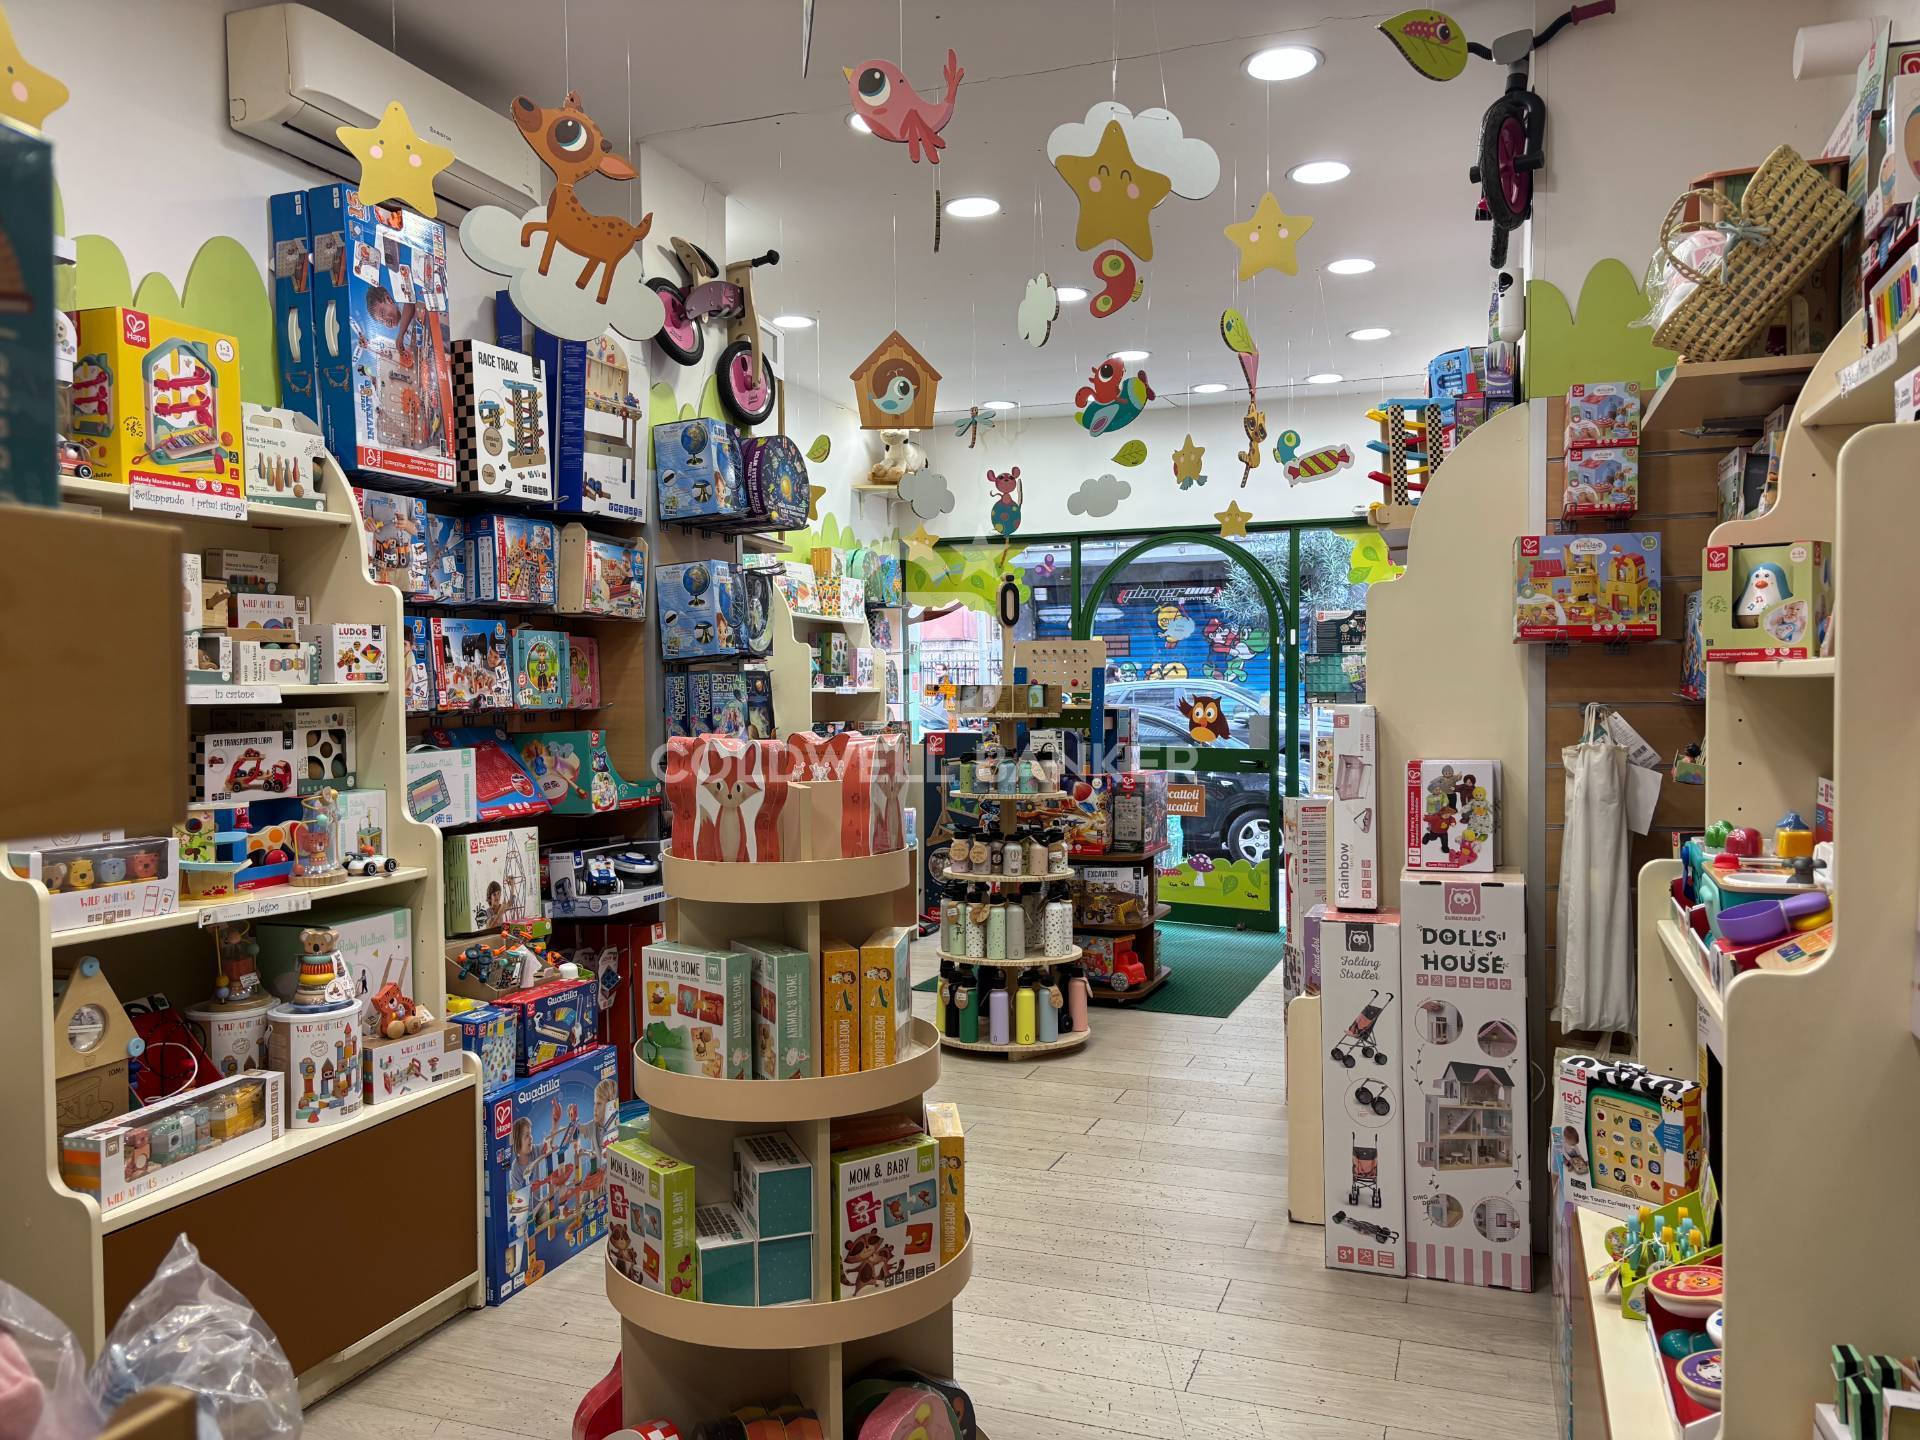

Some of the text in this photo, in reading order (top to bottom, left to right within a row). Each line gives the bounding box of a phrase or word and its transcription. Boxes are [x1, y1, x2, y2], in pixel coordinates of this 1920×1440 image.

[126, 331, 147, 343] Hape
[478, 351, 518, 375] RACE TRACK
[242, 599, 258, 608] WILD
[339, 627, 368, 636] LUDOS
[711, 673, 745, 683] CRYSTAL
[224, 737, 257, 747] TRANSPORTER
[258, 736, 273, 745] LORRY
[1167, 789, 1200, 800] cattoli
[1167, 802, 1199, 813] ucativi
[479, 834, 509, 846] FLEXISTIX
[1087, 870, 1118, 878] EXCAVATOR
[1338, 842, 1350, 899] Rainbow
[648, 956, 679, 973] ANIMAL'S
[681, 960, 700, 977] HOME
[1339, 955, 1381, 971] Folding
[1422, 953, 1505, 974] HOUSE
[1339, 969, 1380, 981] Stroller
[733, 972, 742, 998] HOME
[547, 990, 578, 1006] Quadrilla
[786, 973, 798, 1039] ANIMAL'S HOME
[217, 1023, 235, 1033] WILD
[296, 1023, 314, 1033] WILD
[839, 1019, 850, 1073] PROFESSIONS
[874, 1015, 886, 1067] PROFESSIONS
[518, 1078, 560, 1104] Quadrilla
[610, 1156, 645, 1186] MOM & BABY
[849, 1166, 871, 1185] MOM
[874, 1163, 882, 1178] &
[886, 1157, 909, 1175] BABY
[672, 1191, 684, 1214] BABY
[1573, 1192, 1589, 1200] Magic
[1590, 1195, 1607, 1204] Touch
[673, 1228, 684, 1249] MOM
